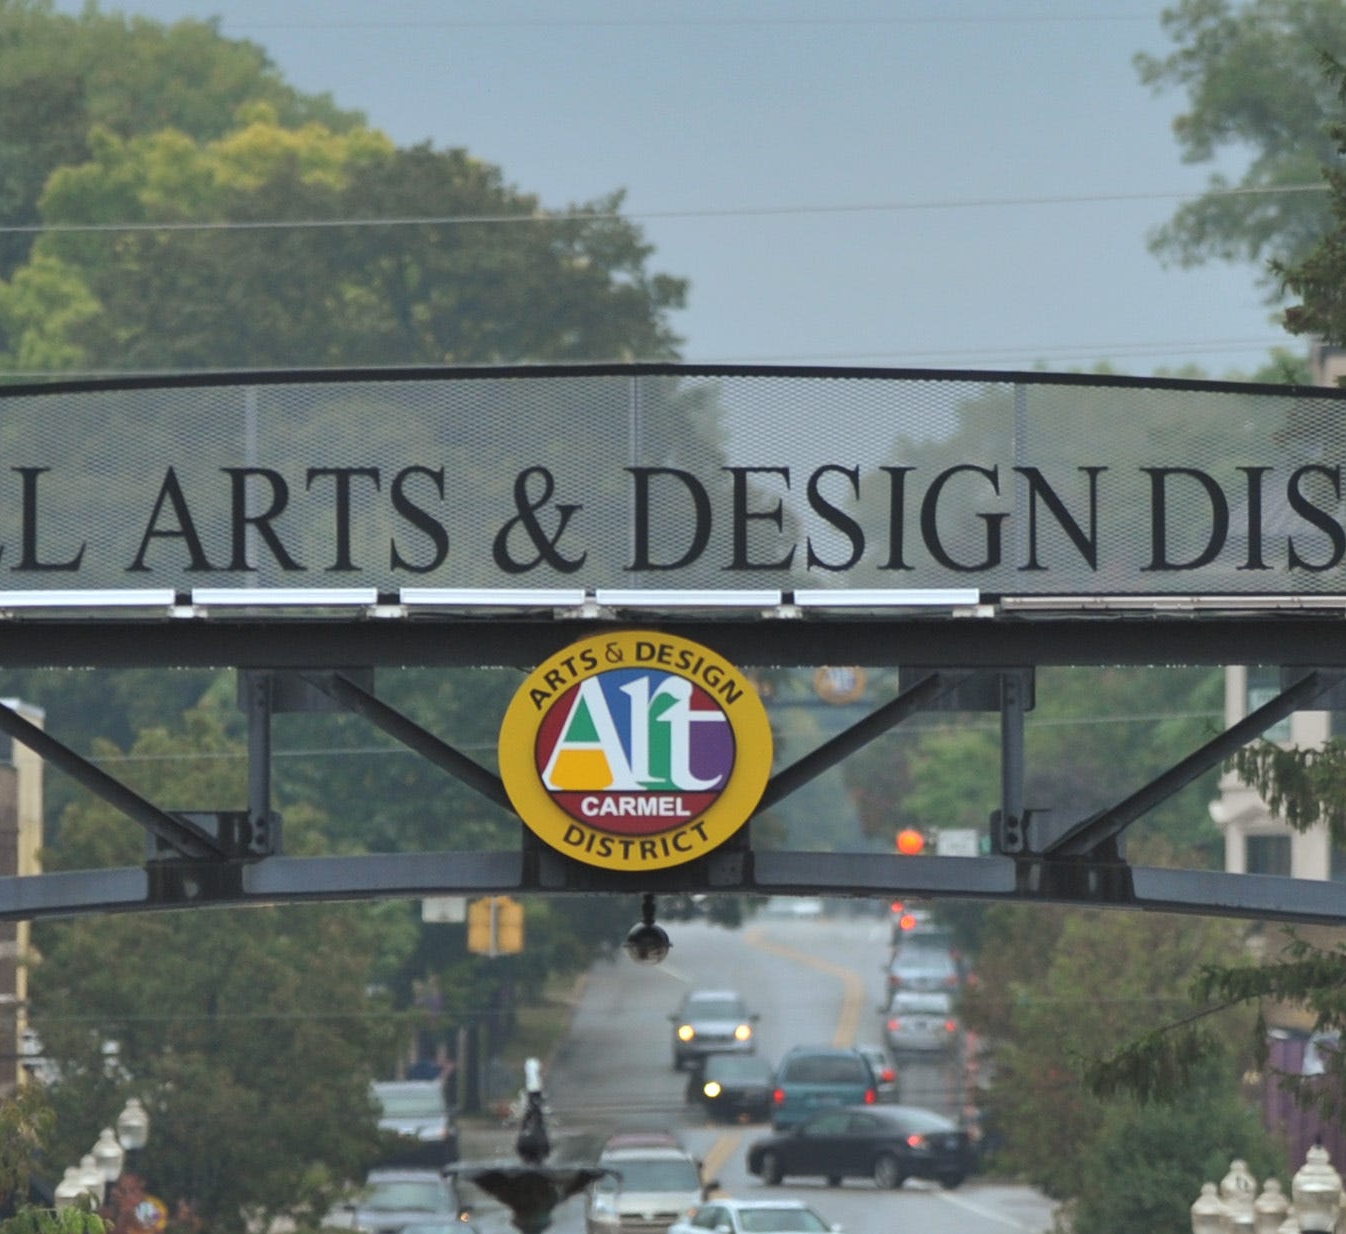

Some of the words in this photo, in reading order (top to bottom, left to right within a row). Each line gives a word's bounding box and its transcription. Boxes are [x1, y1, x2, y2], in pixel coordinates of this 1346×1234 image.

[125, 464, 450, 574] ARTS
[492, 465, 587, 574] &
[622, 463, 1109, 573] DESIGN
[528, 648, 598, 710] ARTS
[605, 642, 624, 663] &
[635, 641, 744, 706] DESIGN
[541, 675, 726, 791] Art
[563, 820, 709, 860] DISTRICT
[581, 796, 691, 817] CARMEL
